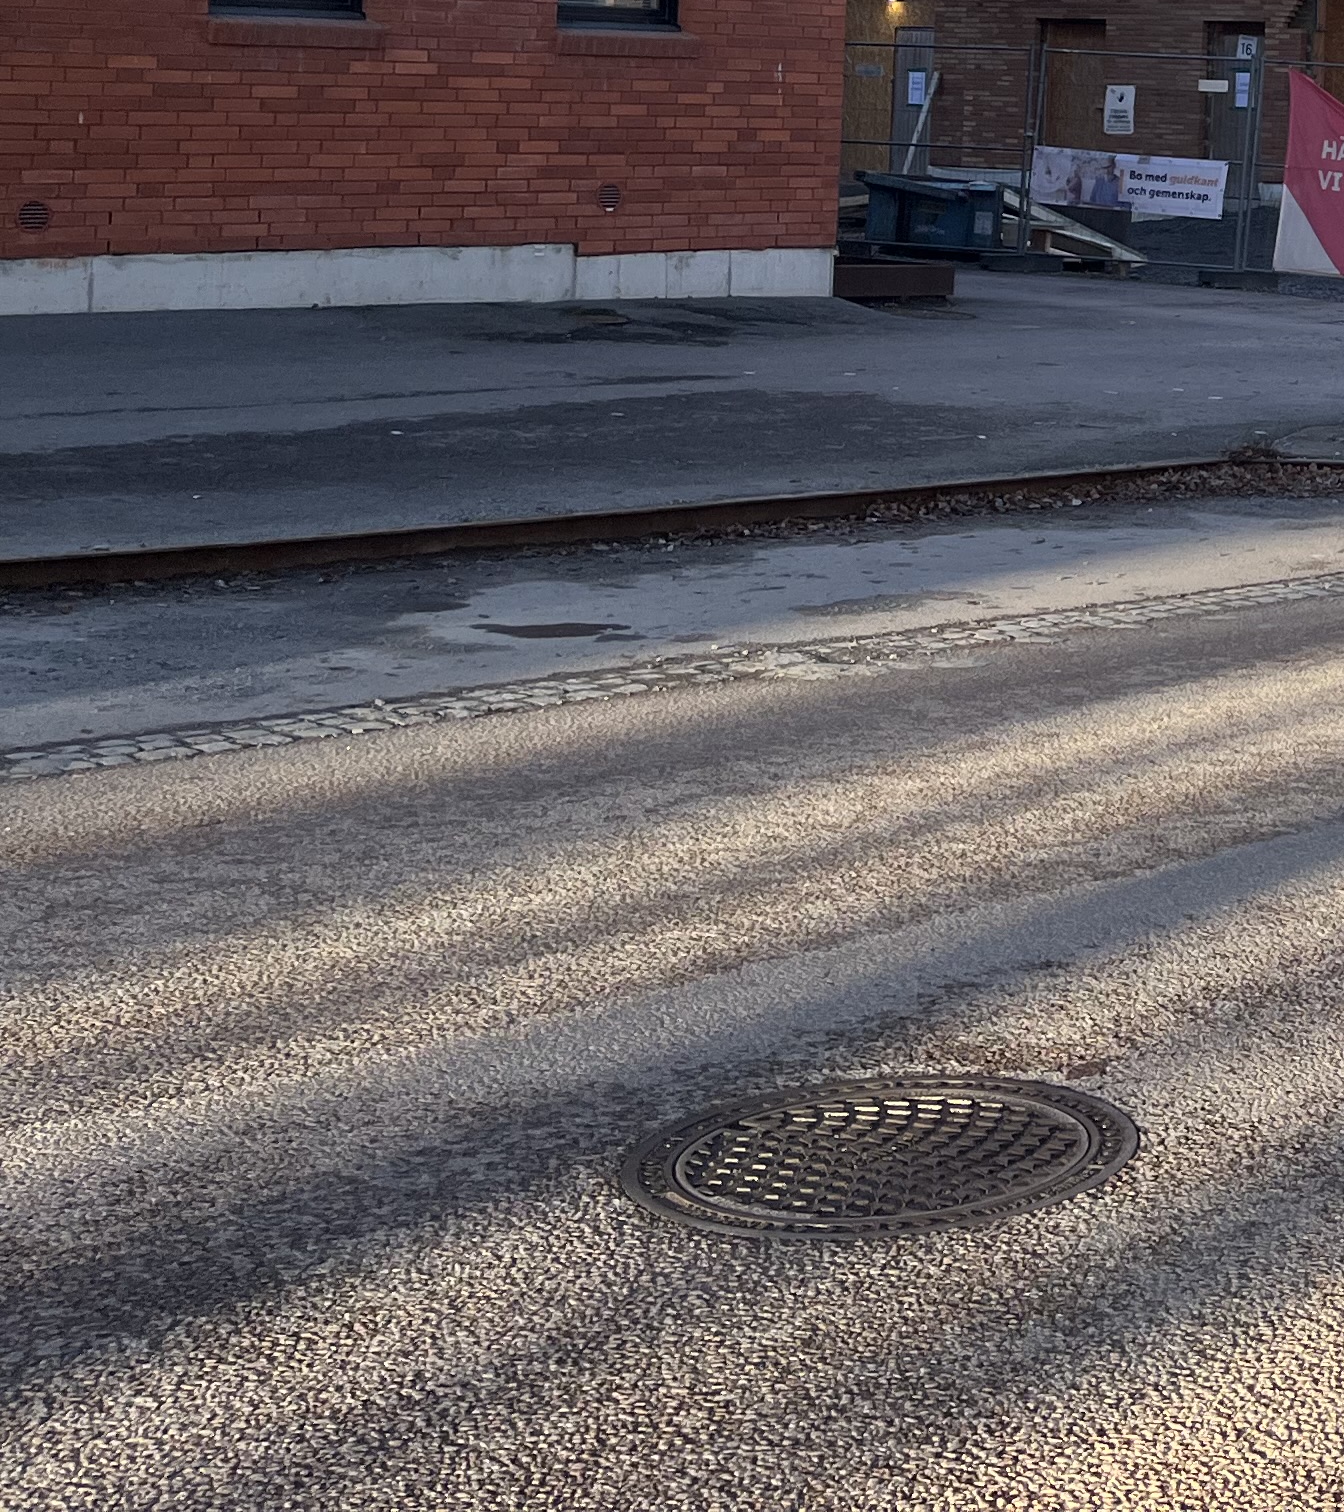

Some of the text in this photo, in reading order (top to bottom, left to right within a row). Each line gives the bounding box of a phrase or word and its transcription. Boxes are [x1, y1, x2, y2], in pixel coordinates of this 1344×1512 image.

[1240, 42, 1253, 56] 16
[1129, 170, 1219, 187] Bo med guldkant
[1318, 170, 1343, 192] VI
[1127, 186, 1212, 204] och gemenskap.
